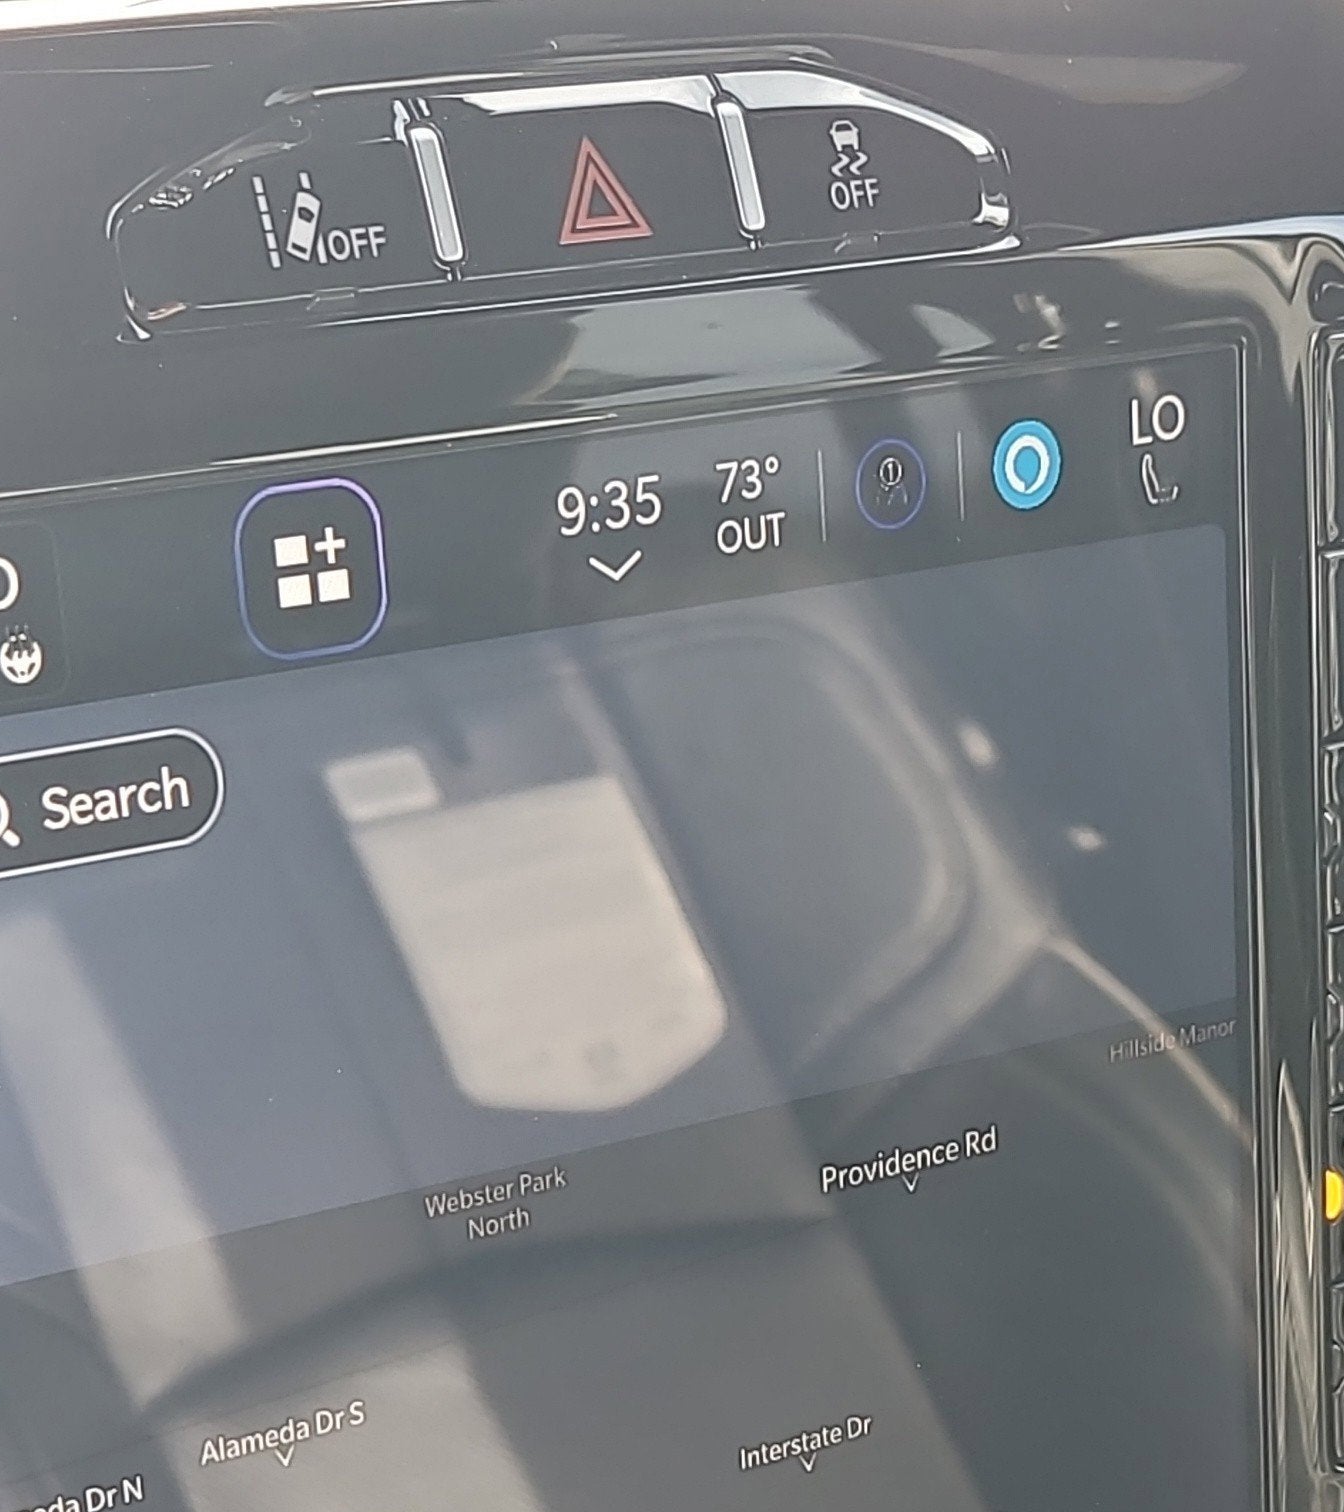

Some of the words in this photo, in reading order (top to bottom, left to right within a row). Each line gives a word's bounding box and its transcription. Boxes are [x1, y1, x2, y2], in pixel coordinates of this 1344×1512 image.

[830, 178, 880, 211] OFF
[327, 225, 387, 262] OFF
[1131, 394, 1186, 445] LO
[714, 456, 780, 504] 73°
[556, 474, 663, 537] 9:35
[715, 512, 786, 554] OUT
[41, 765, 191, 831] Search
[1109, 1032, 1177, 1063] Hillside
[1179, 1020, 1236, 1046] Manor
[818, 1142, 960, 1193] Providence
[964, 1126, 998, 1157] Rd
[425, 1185, 517, 1218] Webster
[520, 1166, 567, 1198] Park
[467, 1207, 530, 1240] North
[200, 1417, 311, 1467] Alameda
[315, 1408, 347, 1437] Dr
[348, 1401, 366, 1427] S
[739, 1427, 842, 1470] Interstate
[845, 1414, 873, 1440] Dr
[122, 1475, 145, 1503] N
